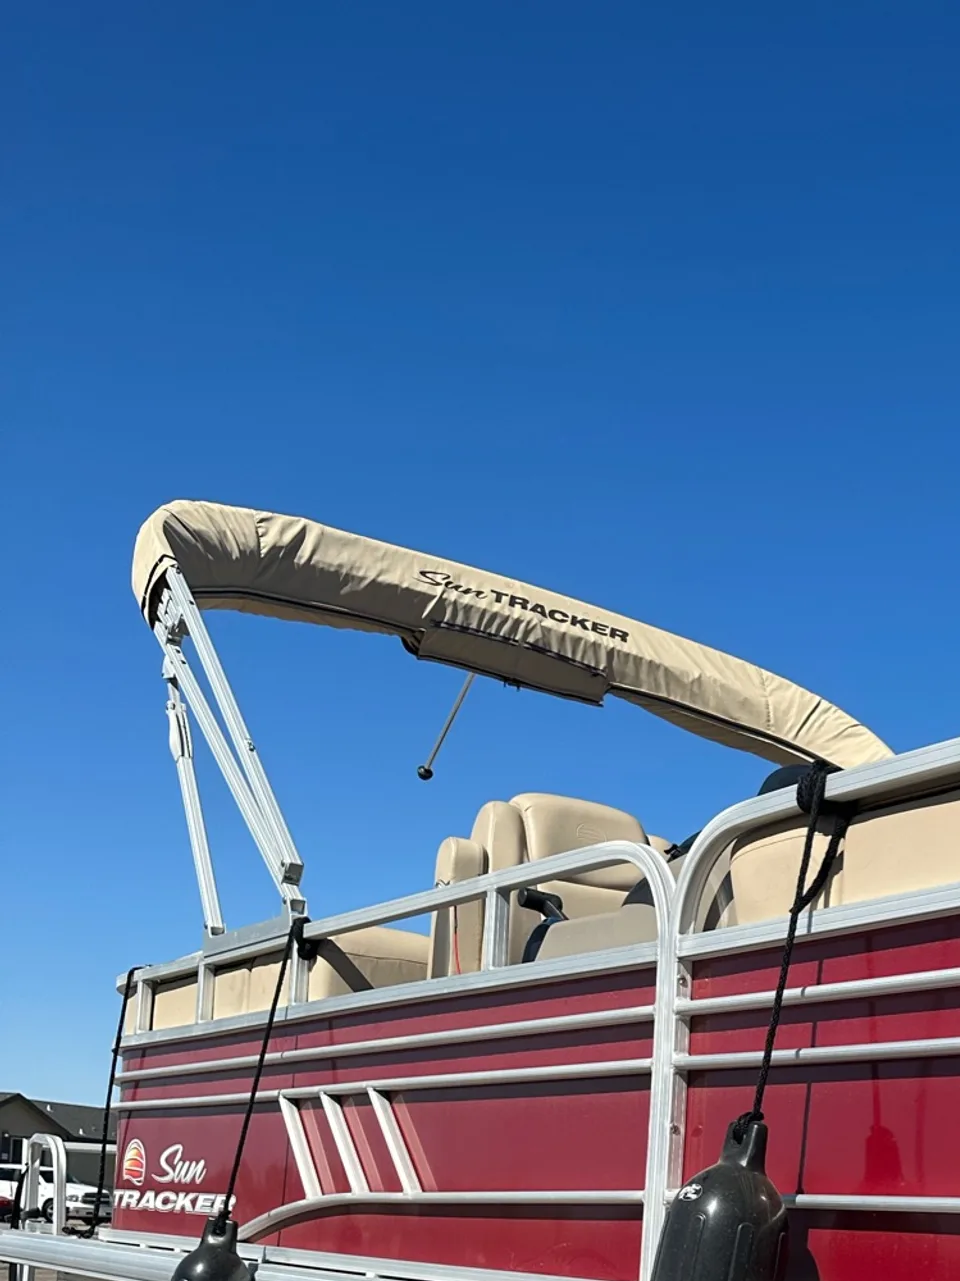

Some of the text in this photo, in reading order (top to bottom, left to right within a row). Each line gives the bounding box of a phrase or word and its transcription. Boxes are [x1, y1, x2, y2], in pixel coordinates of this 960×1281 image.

[413, 570, 630, 643] Sun TRACKER
[151, 1143, 208, 1185] Sun
